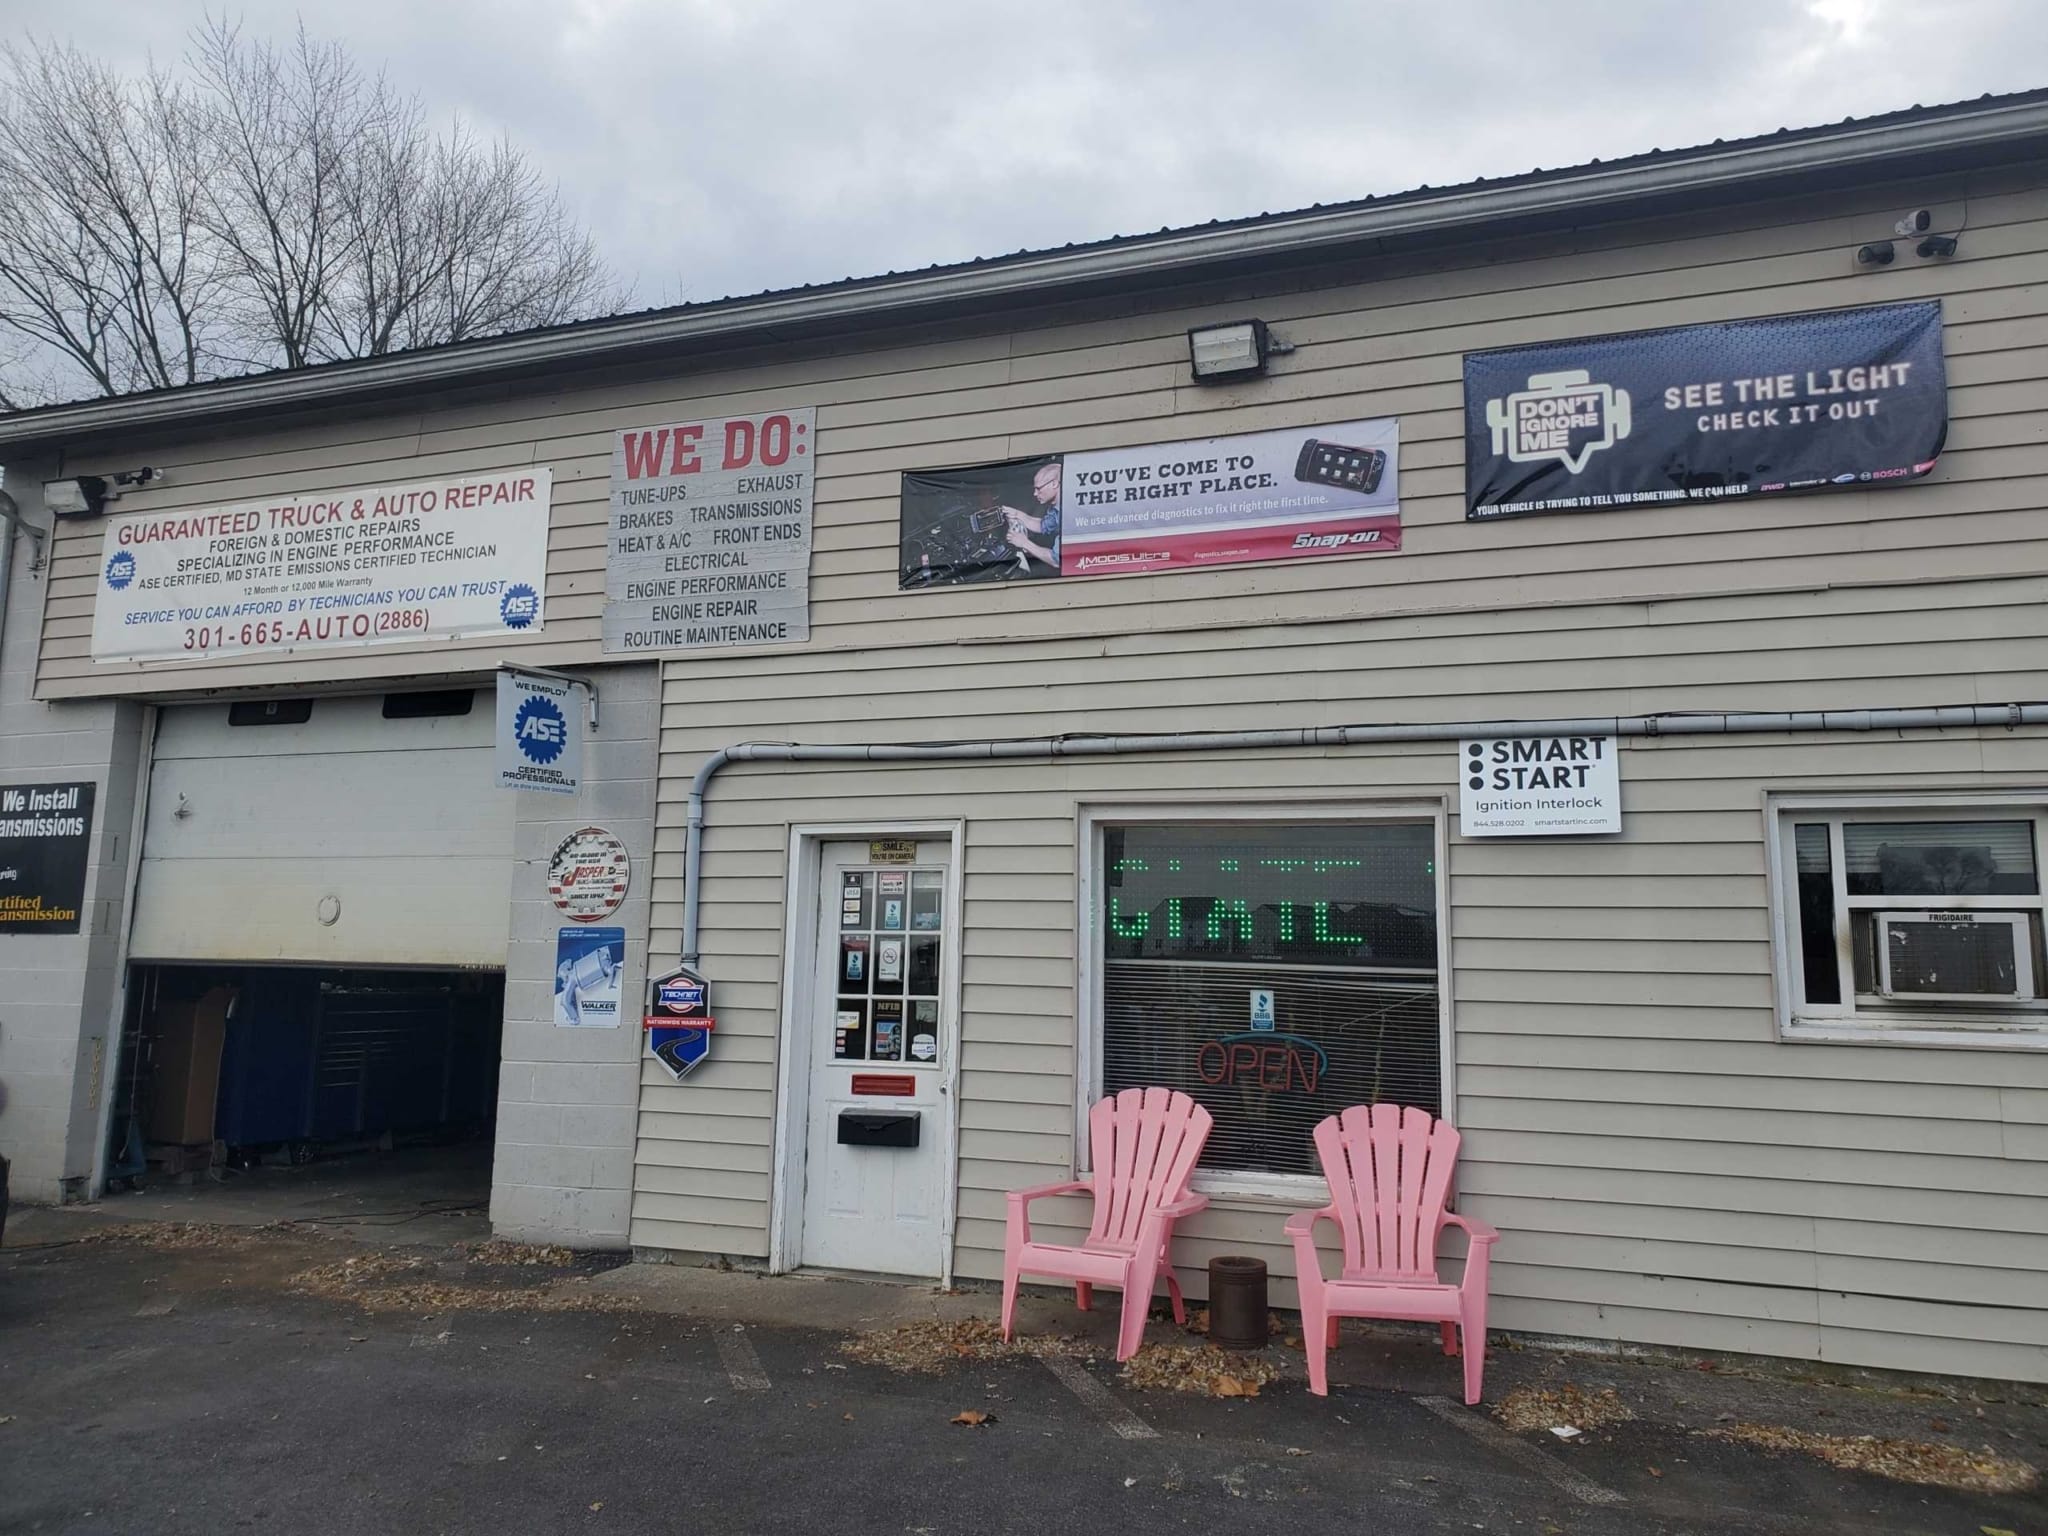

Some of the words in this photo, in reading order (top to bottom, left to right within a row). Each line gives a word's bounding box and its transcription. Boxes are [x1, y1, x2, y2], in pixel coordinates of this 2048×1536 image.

[1664, 383, 1723, 410] SEE
[1733, 374, 1796, 402] THE
[1807, 363, 1911, 395] LIGHT
[1520, 394, 1599, 419] DON'T
[1697, 408, 1780, 432] CHECK
[1789, 405, 1820, 424] IT
[1829, 399, 1880, 420] OUT
[1520, 412, 1599, 432] IGNORE
[623, 424, 704, 480] WE
[722, 414, 806, 470] DO:
[1520, 429, 1569, 451] ME
[1076, 466, 1150, 486] YOU'VE
[1158, 459, 1218, 478] COME
[1226, 455, 1254, 471] TO
[1872, 468, 1907, 479] BOSCH
[737, 473, 803, 494] EXHAUST
[1075, 489, 1117, 506] THE
[1124, 482, 1192, 501] RIGHT
[1200, 473, 1278, 494] PLACE.
[621, 485, 687, 506] TUNE-UPS
[1477, 504, 1499, 515] YOUR
[1500, 502, 1534, 513] VEHICLE
[1535, 500, 1545, 509] IS
[1546, 498, 1578, 509] TRYING
[1580, 497, 1590, 506] TO
[1592, 494, 1612, 505] TELL
[1614, 493, 1631, 503] YOU
[1689, 487, 1704, 498] WE
[1705, 486, 1724, 497] CAN
[118, 511, 261, 545] GUARANTEED
[268, 501, 344, 529] TRUCK
[350, 498, 365, 520] &
[373, 490, 437, 518] AUTO
[445, 478, 535, 510] REPAIR
[619, 510, 673, 530] BRAKES
[690, 498, 802, 524] TRANSMISSIONS
[1075, 517, 1088, 527] We
[1090, 517, 1106, 526] use
[1108, 511, 1149, 524] advanced
[1151, 506, 1201, 521] diagnostics
[1204, 505, 1213, 515] to
[1215, 503, 1228, 514] fix
[1230, 502, 1237, 512] it
[1239, 499, 1261, 513] right
[1263, 498, 1279, 509] the
[1281, 496, 1302, 507] first
[1304, 494, 1328, 505] time.
[210, 535, 267, 554] FOREIGN
[271, 532, 280, 547] &
[284, 525, 355, 544] DOMESTIC
[358, 518, 421, 538] REPAIRS
[618, 536, 653, 554] HEAT
[656, 534, 666, 550] &
[669, 532, 692, 549] A/C
[713, 526, 760, 545] FRONT
[764, 523, 802, 542] ENDS
[1291, 530, 1380, 548] Snap-on
[177, 551, 266, 572] SPECIALIZING
[270, 549, 284, 563] IN
[287, 544, 337, 562] ENGINE
[344, 531, 455, 556] PERFORMANCE
[665, 552, 749, 572] ELECTRICAL
[111, 562, 133, 577] ASE
[138, 577, 161, 590] ASE
[163, 572, 222, 588] CERTIFIED,
[226, 570, 242, 582] MD
[245, 565, 281, 579] STATE
[287, 559, 350, 576] EMISSIONS
[354, 553, 416, 570] CERTIFIED
[421, 544, 496, 563] TECHNICIAN
[243, 587, 252, 596] 12
[254, 585, 278, 595] Month
[281, 585, 289, 593] or
[292, 582, 316, 593] 12,000
[318, 579, 334, 589] Mile
[336, 576, 373, 588] Warranty
[627, 581, 676, 599] ENGINE
[681, 572, 787, 595] PERFORMANCE
[125, 610, 175, 625] SERVICE
[178, 607, 202, 621] YOU
[205, 605, 230, 618] CAN
[232, 600, 282, 616] AFFORD
[287, 598, 306, 612] BY
[309, 590, 393, 609] TECHNICIANS
[398, 588, 425, 602] YOU
[428, 585, 457, 599] CAN
[462, 580, 507, 597] TRUST
[505, 596, 533, 613] ASE
[652, 603, 702, 622] ENGINE
[706, 599, 758, 617] REPAIR
[624, 629, 682, 647] ROUTINE
[686, 622, 787, 644] MAINTENANCE
[515, 680, 531, 691] WE
[531, 683, 568, 697] EMPLOY
[520, 716, 560, 743] ASE
[1491, 736, 1607, 764] SMART
[502, 771, 576, 786] PROFESSIONALS
[518, 766, 562, 777] CERTIFIED
[1492, 765, 1590, 790] START
[2, 790, 25, 812] We
[28, 787, 79, 811] Install
[1475, 799, 1532, 813] Ignition
[1537, 797, 1602, 810] Interlock
[1535, 818, 1607, 827] smartstartinc.com
[562, 866, 605, 887] JASPER
[1928, 913, 1974, 922] FRIGIDAIRE
[664, 990, 699, 998] TECHNET
[581, 1002, 616, 1012] WALKER
[1198, 1041, 1319, 1094] OPEN
